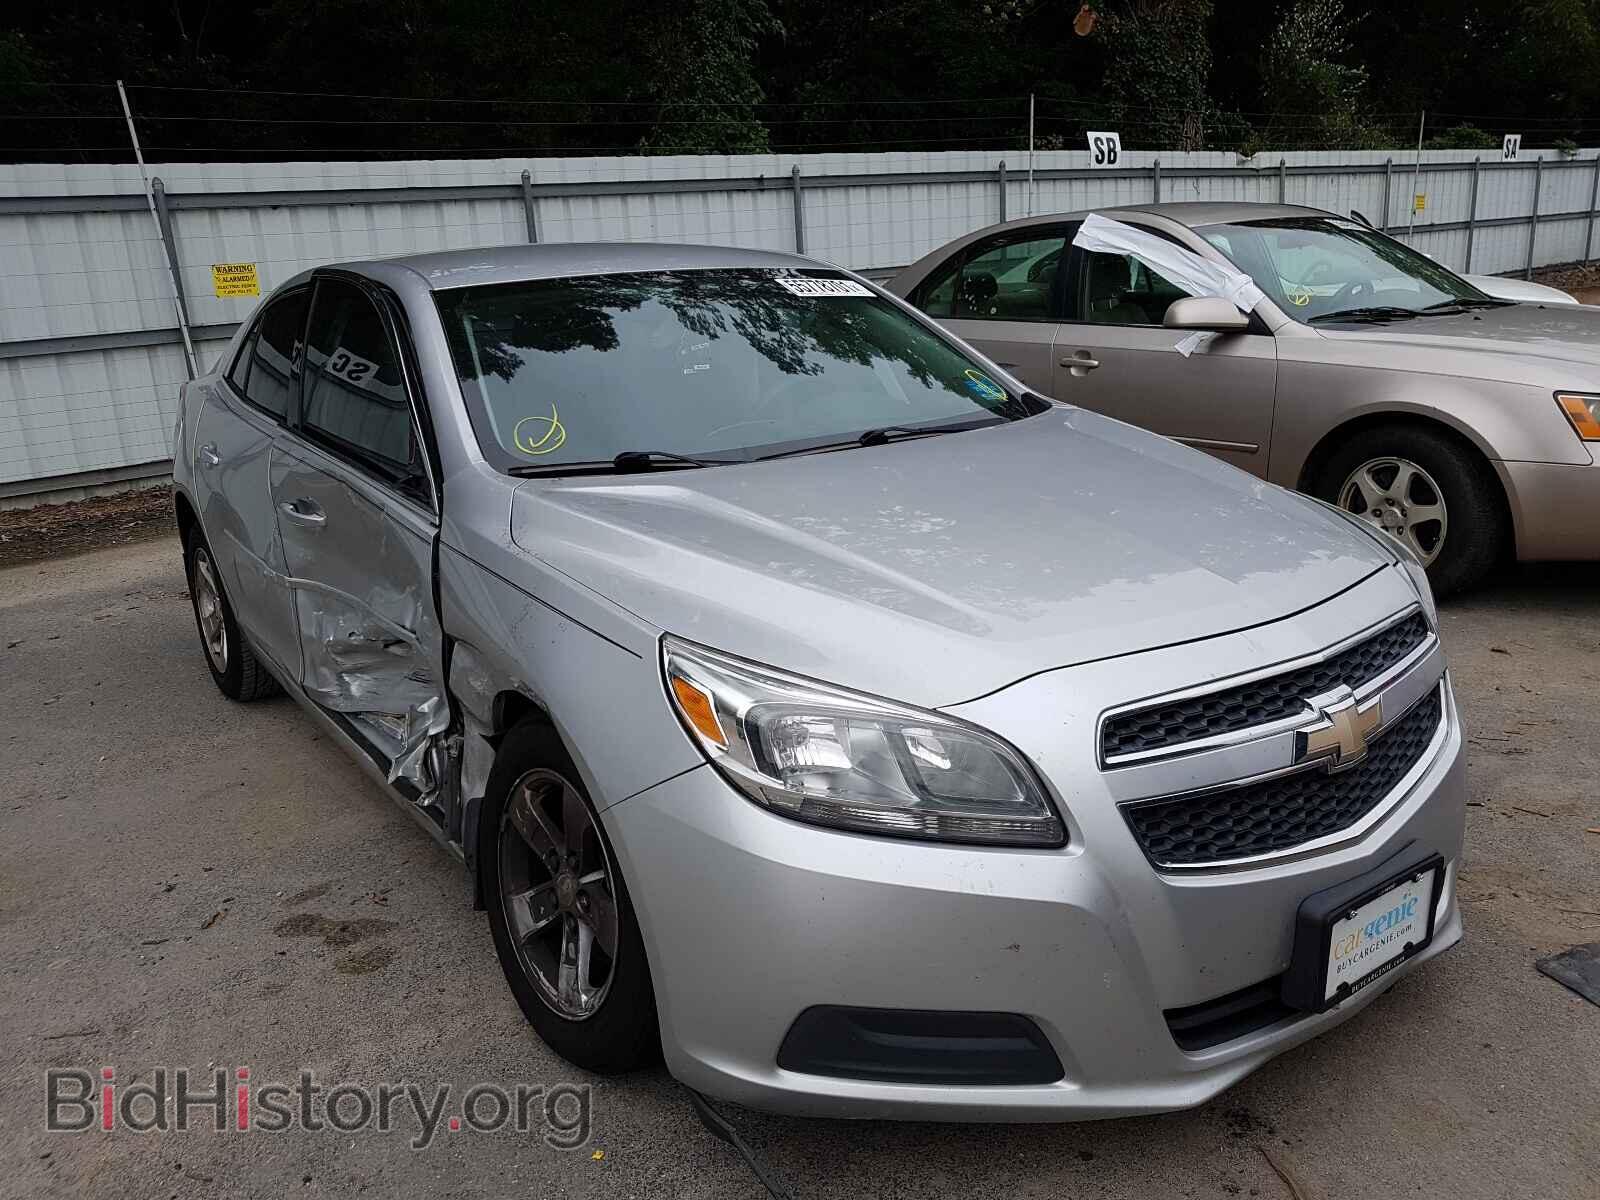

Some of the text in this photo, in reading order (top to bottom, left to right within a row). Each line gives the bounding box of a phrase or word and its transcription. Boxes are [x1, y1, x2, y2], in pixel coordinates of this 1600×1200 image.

[1093, 136, 1118, 165] SB
[1504, 138, 1517, 159] SA
[215, 265, 253, 273] WARNING
